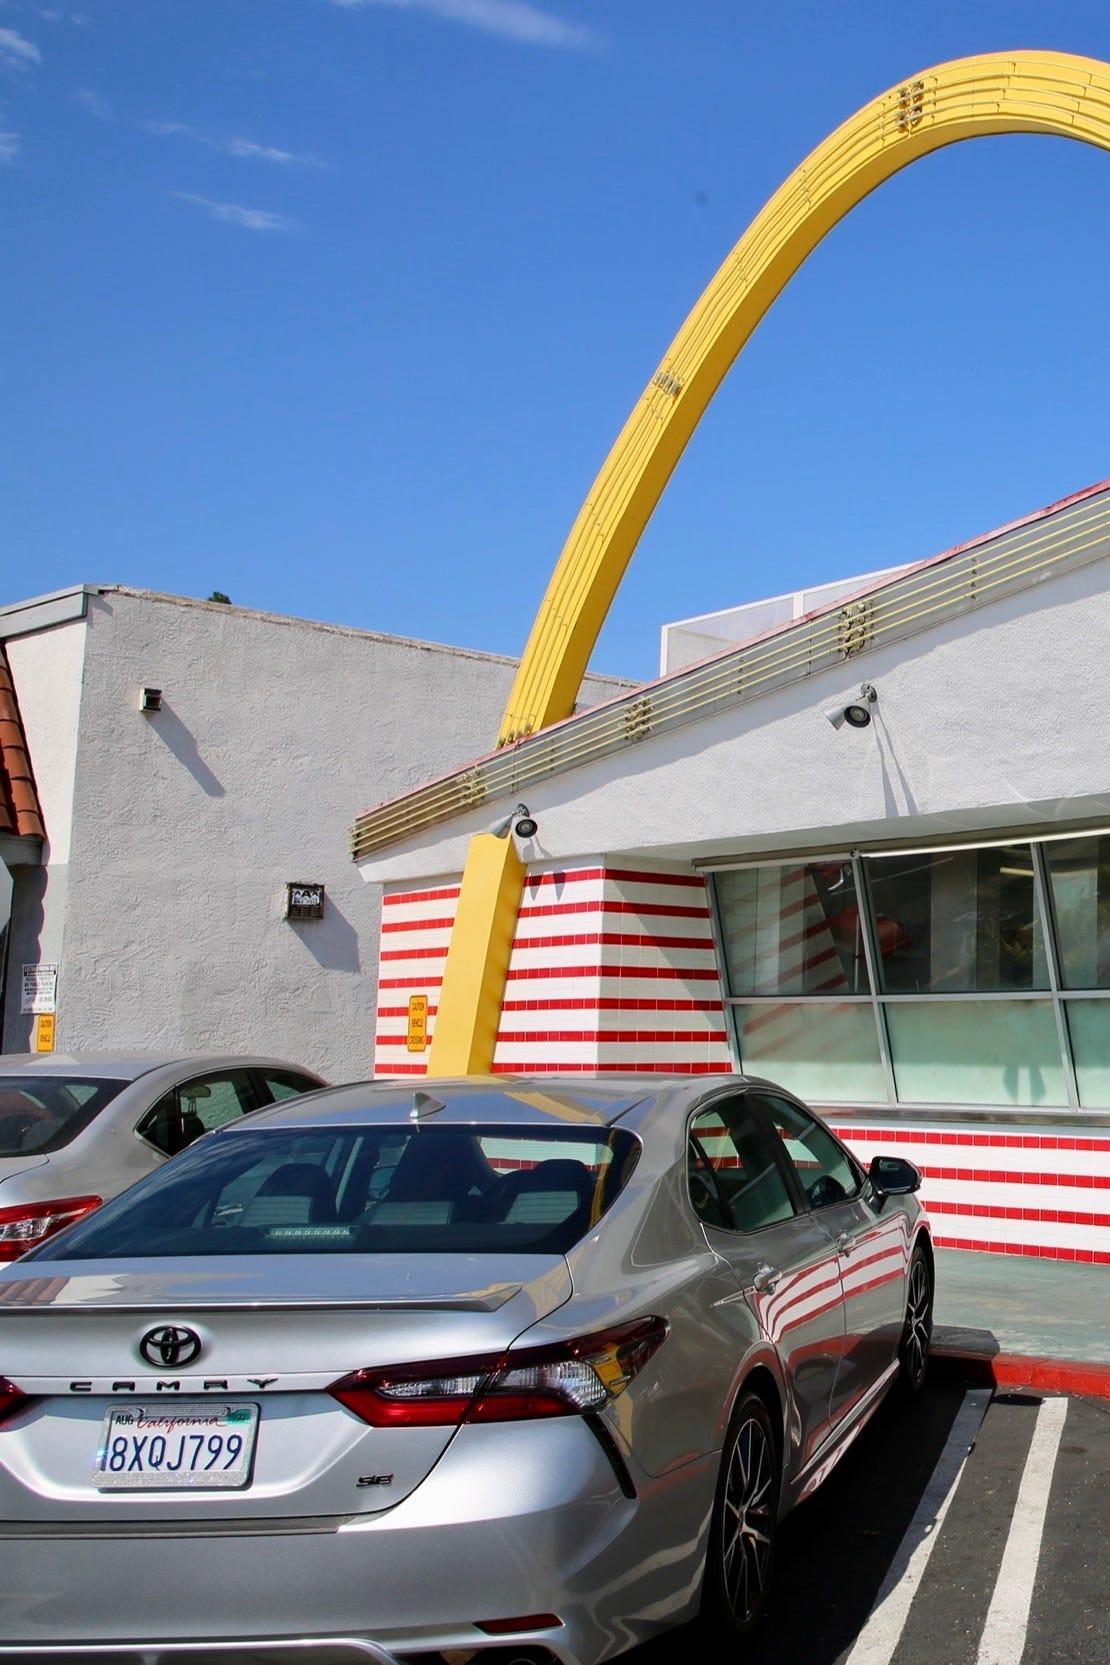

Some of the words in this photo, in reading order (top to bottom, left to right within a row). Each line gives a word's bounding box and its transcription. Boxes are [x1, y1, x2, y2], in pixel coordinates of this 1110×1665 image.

[69, 1378, 279, 1393] CAMRY
[115, 1414, 134, 1426] AUG
[136, 1414, 228, 1434] California
[108, 1433, 244, 1473] 8XQJ799
